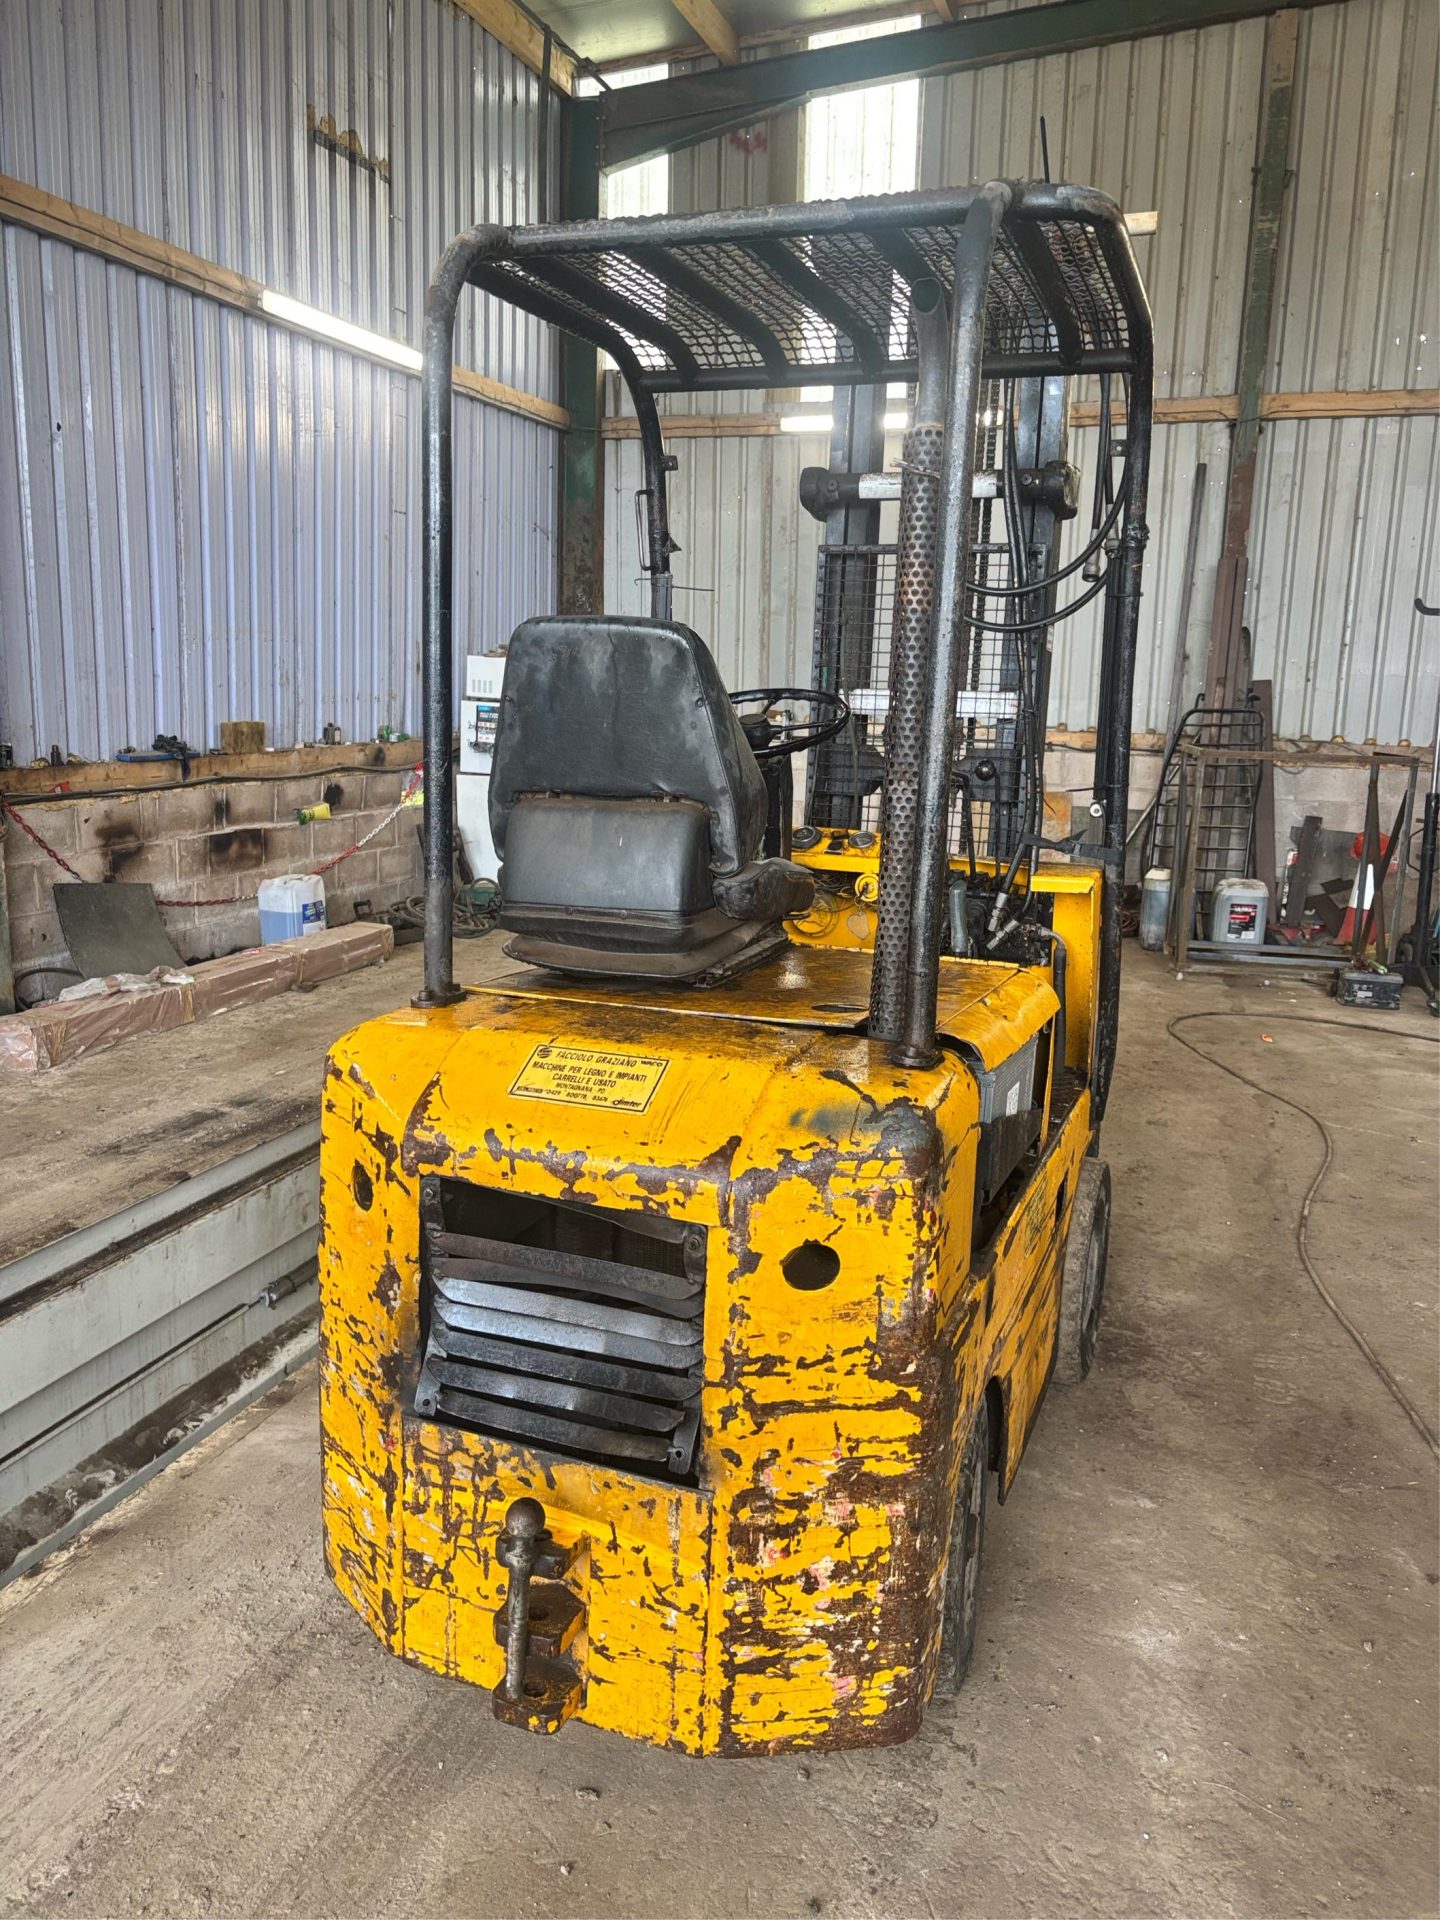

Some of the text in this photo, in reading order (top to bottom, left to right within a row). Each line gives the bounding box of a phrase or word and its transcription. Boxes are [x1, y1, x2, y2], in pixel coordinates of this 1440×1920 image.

[556, 1051, 637, 1067] FACCIOLO GRAZIANO
[532, 1061, 567, 1072] MACCHINE
[583, 1068, 606, 1077] LEGNO
[615, 1072, 647, 1082] IMPIANTI
[552, 1073, 586, 1083] CARRELLI
[593, 1078, 617, 1088] USATO
